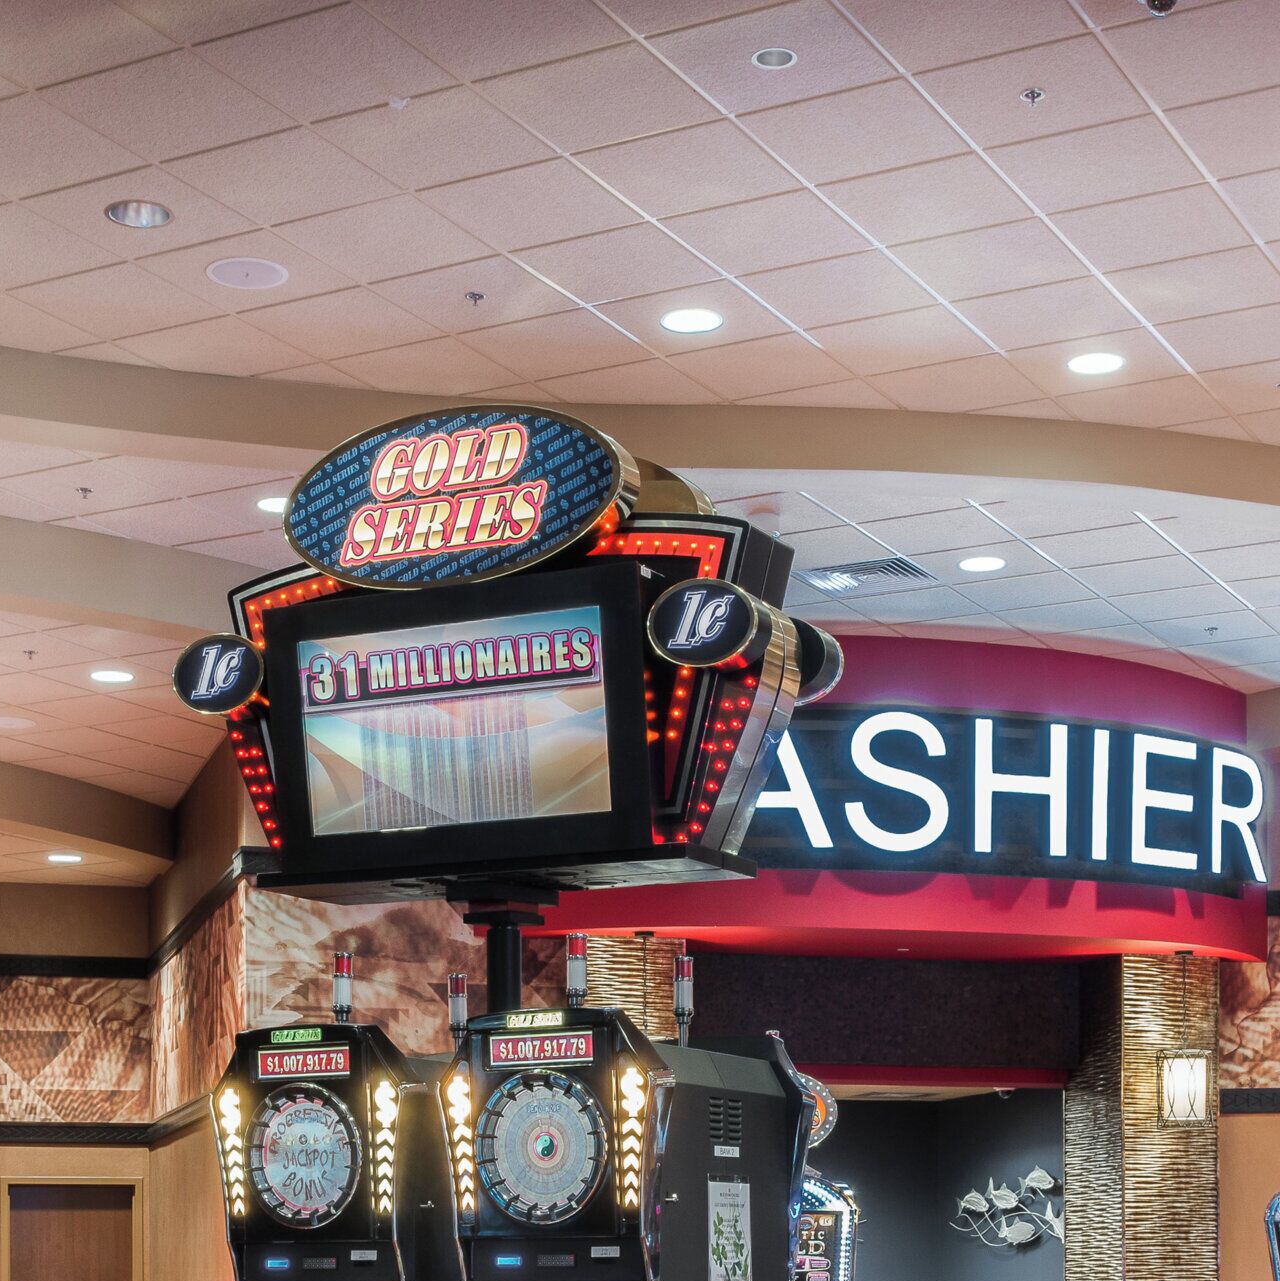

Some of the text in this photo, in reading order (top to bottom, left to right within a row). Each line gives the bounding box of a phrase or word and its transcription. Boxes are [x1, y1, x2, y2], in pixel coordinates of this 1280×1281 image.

[547, 434, 570, 453] GOLD
[336, 447, 358, 467] GOLD
[373, 426, 524, 498] GOLD
[521, 466, 543, 484] GOLD
[544, 448, 574, 471] SERIES
[560, 458, 583, 478] GOLD
[309, 478, 332, 498] GOLD
[332, 461, 360, 484] SERIES
[557, 473, 587, 497] SERIES
[307, 491, 335, 515] SERIES
[573, 484, 596, 503] GOLD
[322, 502, 344, 521] GOLD
[343, 483, 544, 562] SERIES
[545, 498, 600, 534] GOLD SERIES
[319, 515, 347, 537] SERIES
[436, 561, 458, 580] GOLD
[476, 553, 499, 572] GOLD
[668, 590, 736, 648] 1¢
[368, 627, 595, 692] MILLIONAIRES
[191, 644, 246, 700] 1¢
[754, 710, 1268, 884] ASHIER
[499, 1037, 586, 1060] $1,007,917.79
[267, 1052, 344, 1073] $1,007,917.79
[282, 1150, 336, 1170] JACKPOT
[801, 1230, 825, 1240] TIC
